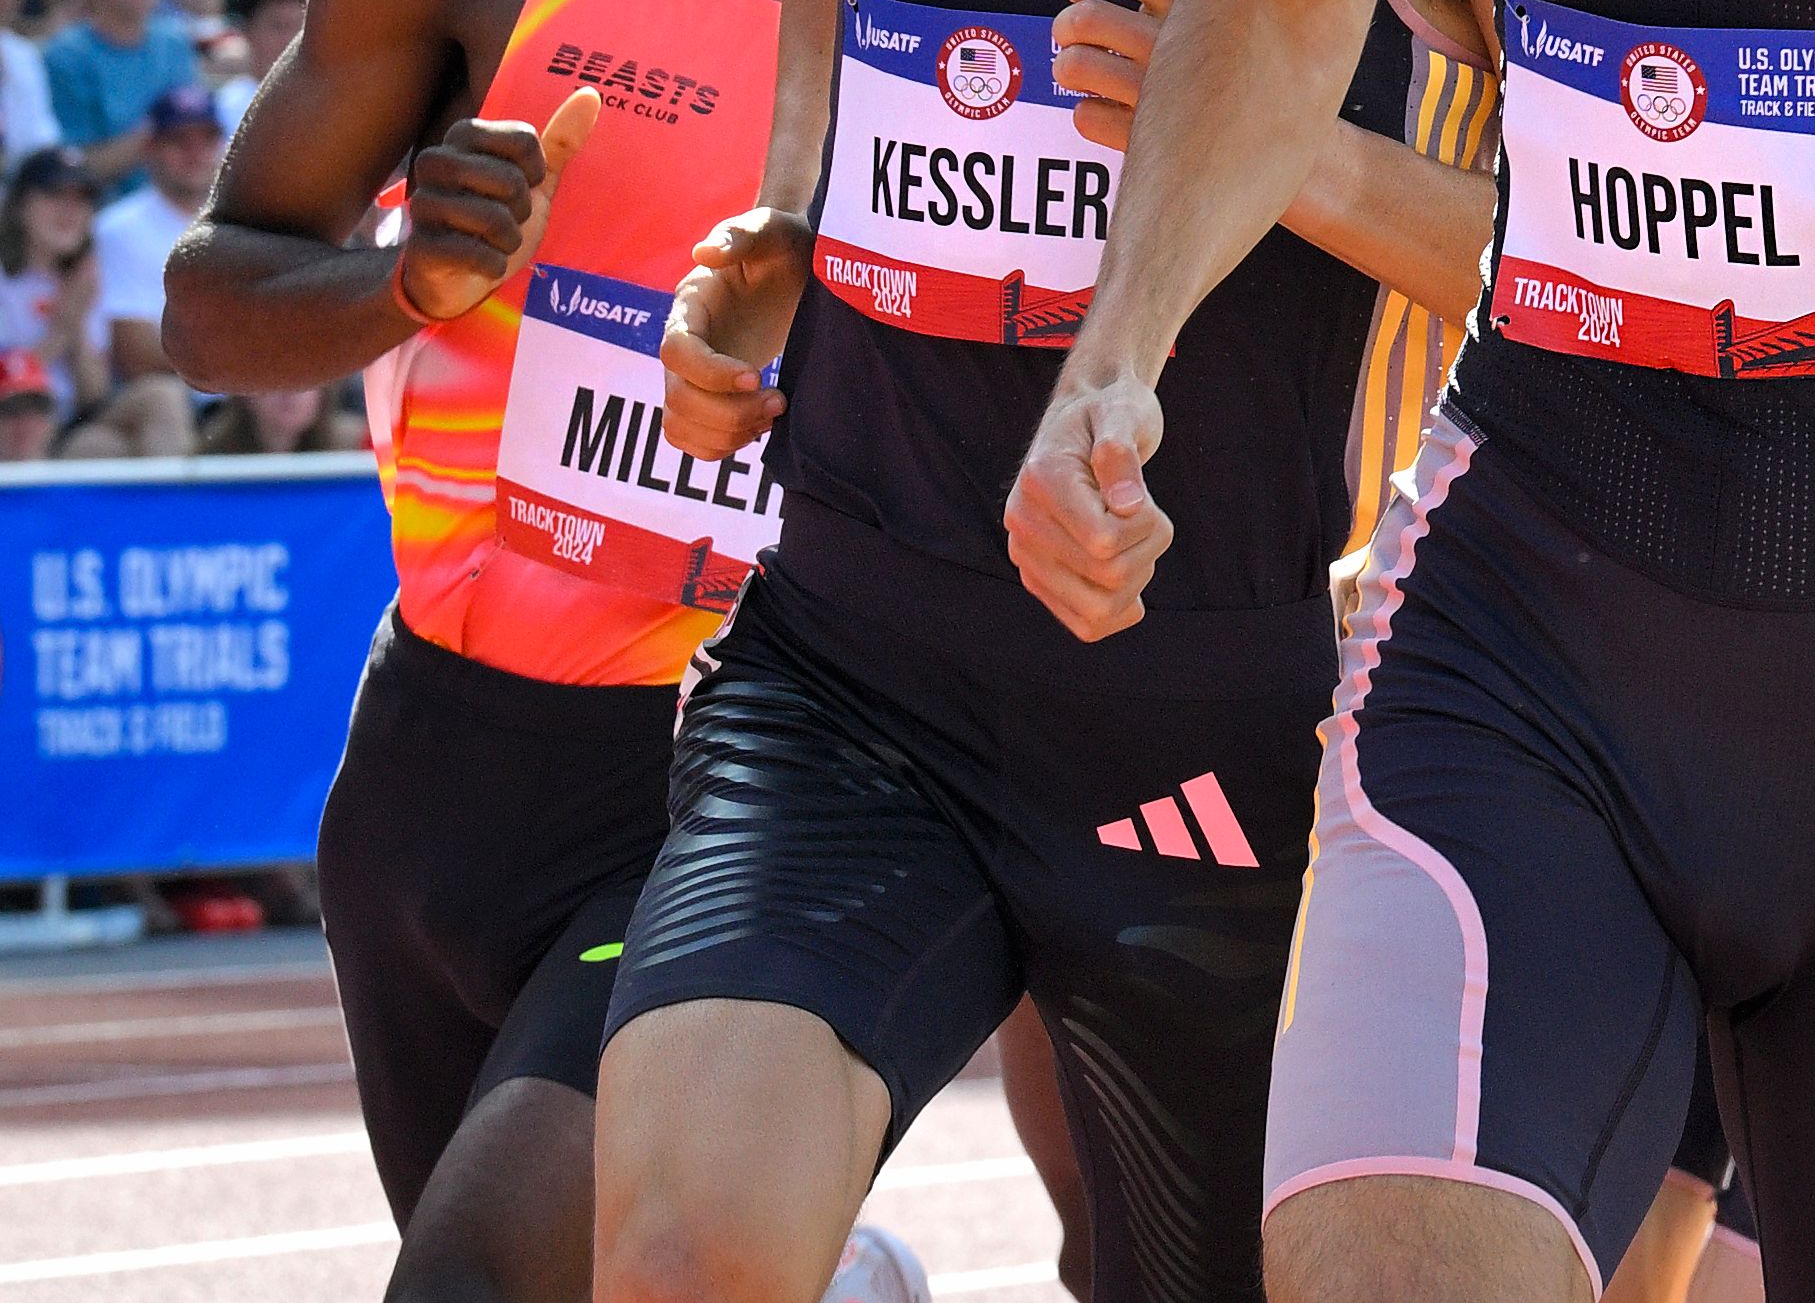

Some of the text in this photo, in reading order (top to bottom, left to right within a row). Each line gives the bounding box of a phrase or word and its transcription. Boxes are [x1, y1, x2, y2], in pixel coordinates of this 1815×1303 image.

[871, 27, 922, 54] USATF
[945, 28, 1014, 56] UNITED STATES
[1544, 35, 1605, 67] USATF
[1626, 44, 1697, 74] UNITED STATES
[1738, 47, 1774, 71] U.S.
[547, 42, 720, 115] BEASTS
[1738, 74, 1789, 97] TEAM
[633, 102, 680, 125] CLUB
[944, 92, 1011, 118] OLYMPIC TEAM
[1740, 100, 1781, 117] TRACK
[1784, 101, 1793, 117] &
[1630, 111, 1698, 141] OLYMPIC TEAM
[872, 136, 1110, 240] KESSLER
[1569, 157, 1800, 267] HOPPEL
[825, 255, 917, 297] TRACKTOWN
[580, 297, 652, 327] USATF
[872, 288, 912, 319] 2024
[1514, 277, 1623, 326] TRACKTOWN
[1578, 313, 1621, 348] 2024
[509, 496, 606, 546] TRACKTOWN
[553, 534, 592, 565] 2024
[119, 544, 290, 618] OLYMPIC
[33, 619, 290, 699] TEAM TRIALS
